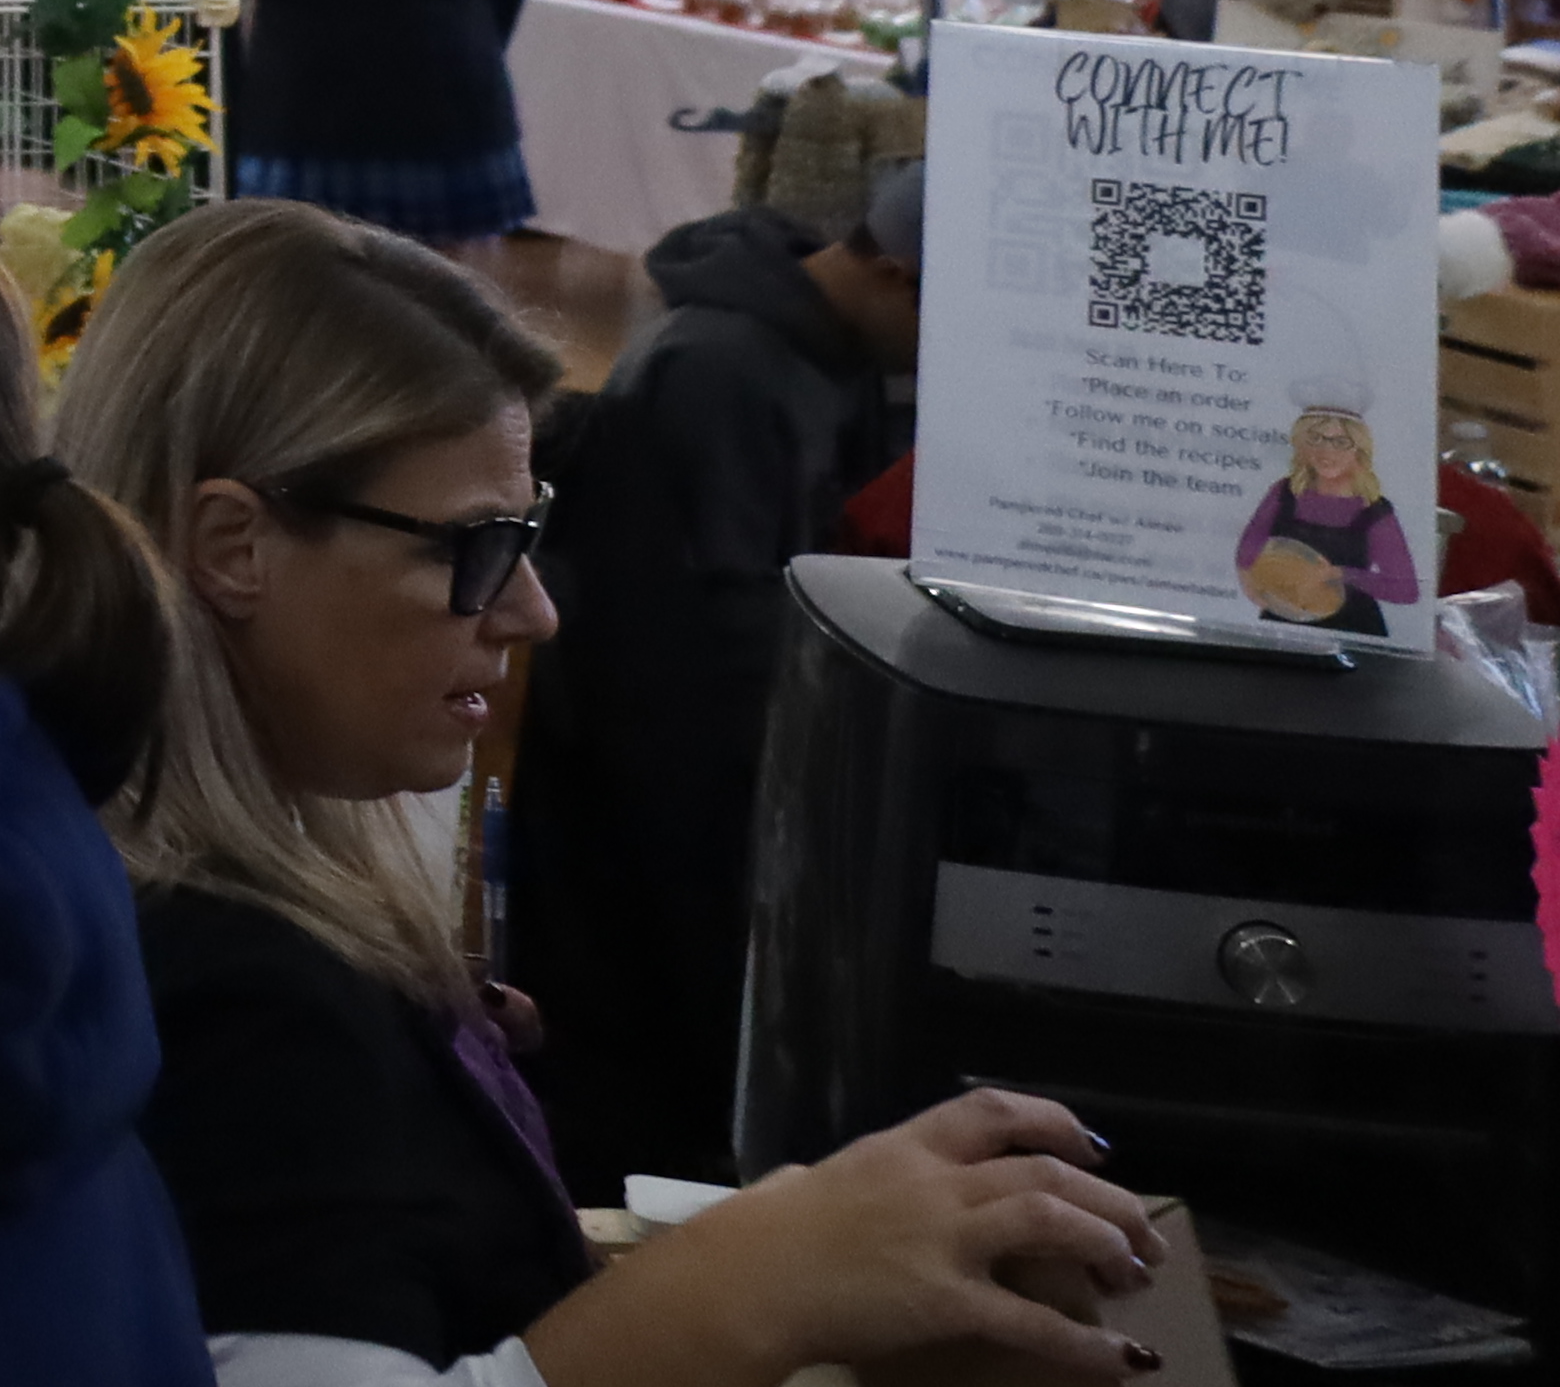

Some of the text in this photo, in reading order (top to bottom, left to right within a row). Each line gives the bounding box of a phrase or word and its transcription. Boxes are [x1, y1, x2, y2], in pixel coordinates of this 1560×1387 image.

[1055, 51, 1304, 119] CONNECT
[1067, 98, 1289, 166] WITH ME!
[1086, 348, 1248, 383] Scan Here To:
[1156, 389, 1182, 404] an
[1191, 391, 1251, 411] order
[1133, 413, 1167, 427] me
[1175, 418, 1203, 433] on
[1212, 424, 1289, 446] socials
[1135, 440, 1169, 459] the
[1178, 447, 1262, 471] recipes
[1143, 468, 1178, 488] the
[1187, 476, 1242, 497] team
